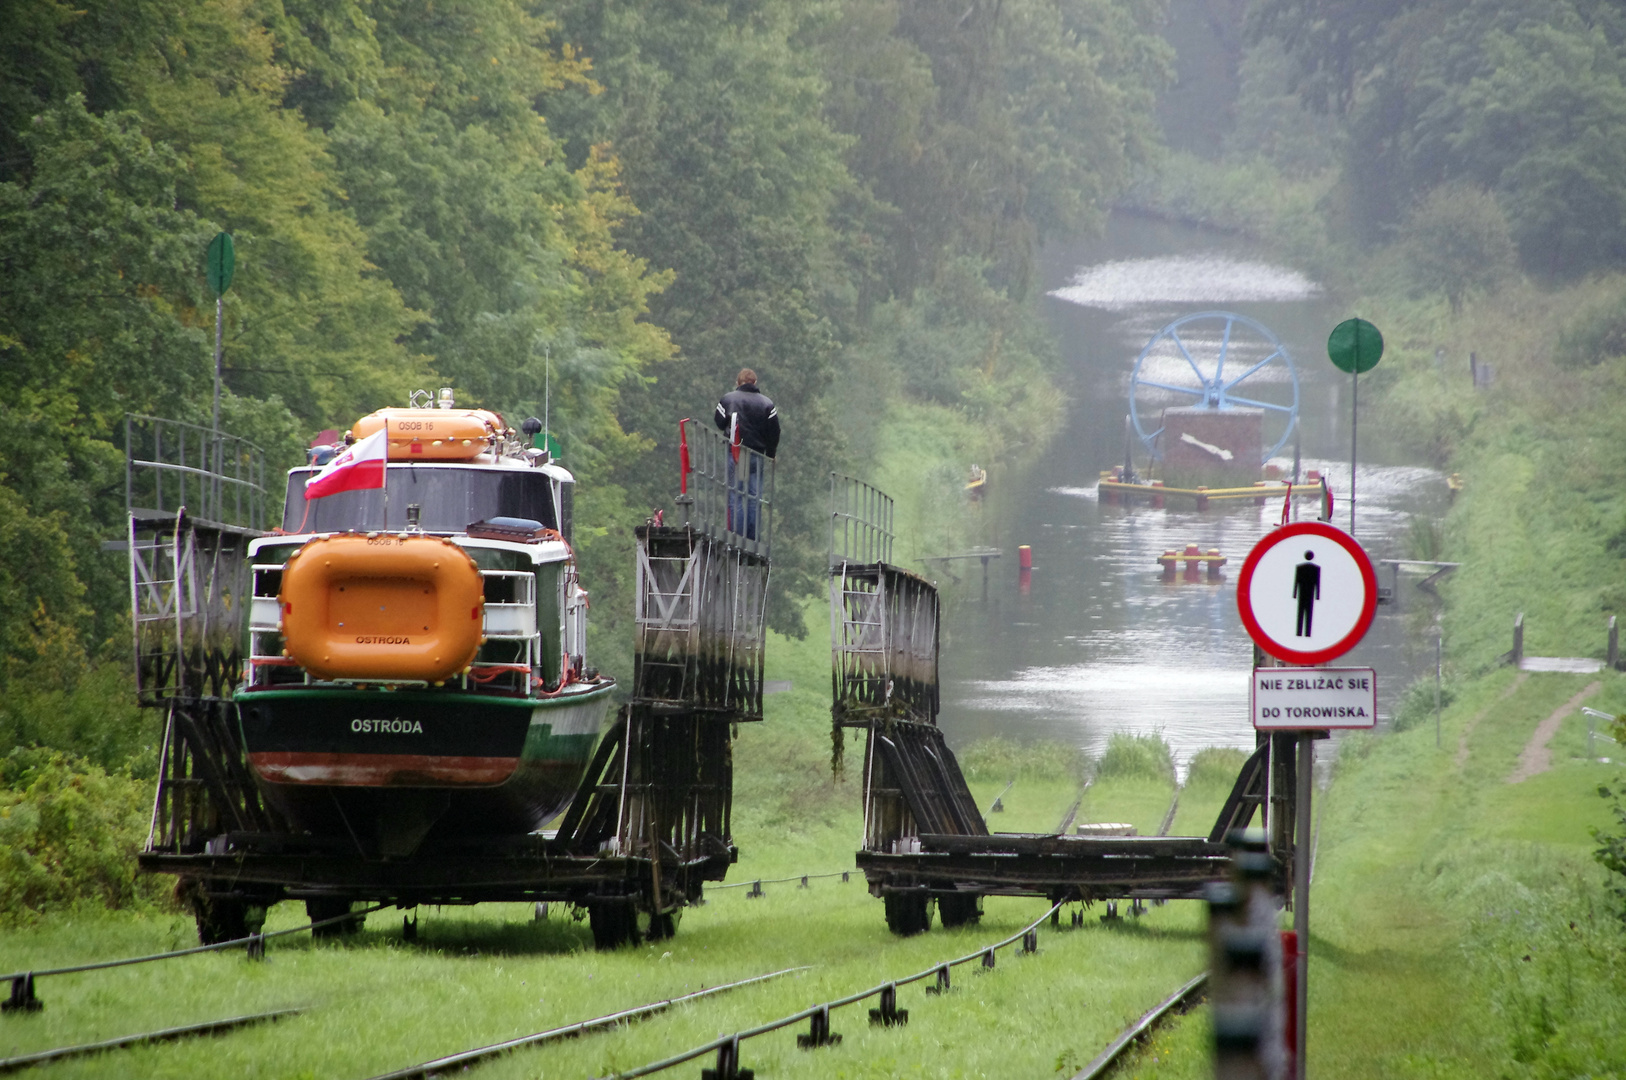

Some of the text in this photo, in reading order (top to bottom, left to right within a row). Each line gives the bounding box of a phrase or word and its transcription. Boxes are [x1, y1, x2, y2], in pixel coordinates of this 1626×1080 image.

[398, 421, 434, 431] OSOB 16
[367, 538, 392, 546] OSOB
[1260, 676, 1369, 692] NIE ZBLIŻAĆ SIĘ
[1262, 706, 1369, 718] DO TOROWISKA.
[351, 717, 423, 734] OSTRÓDA
